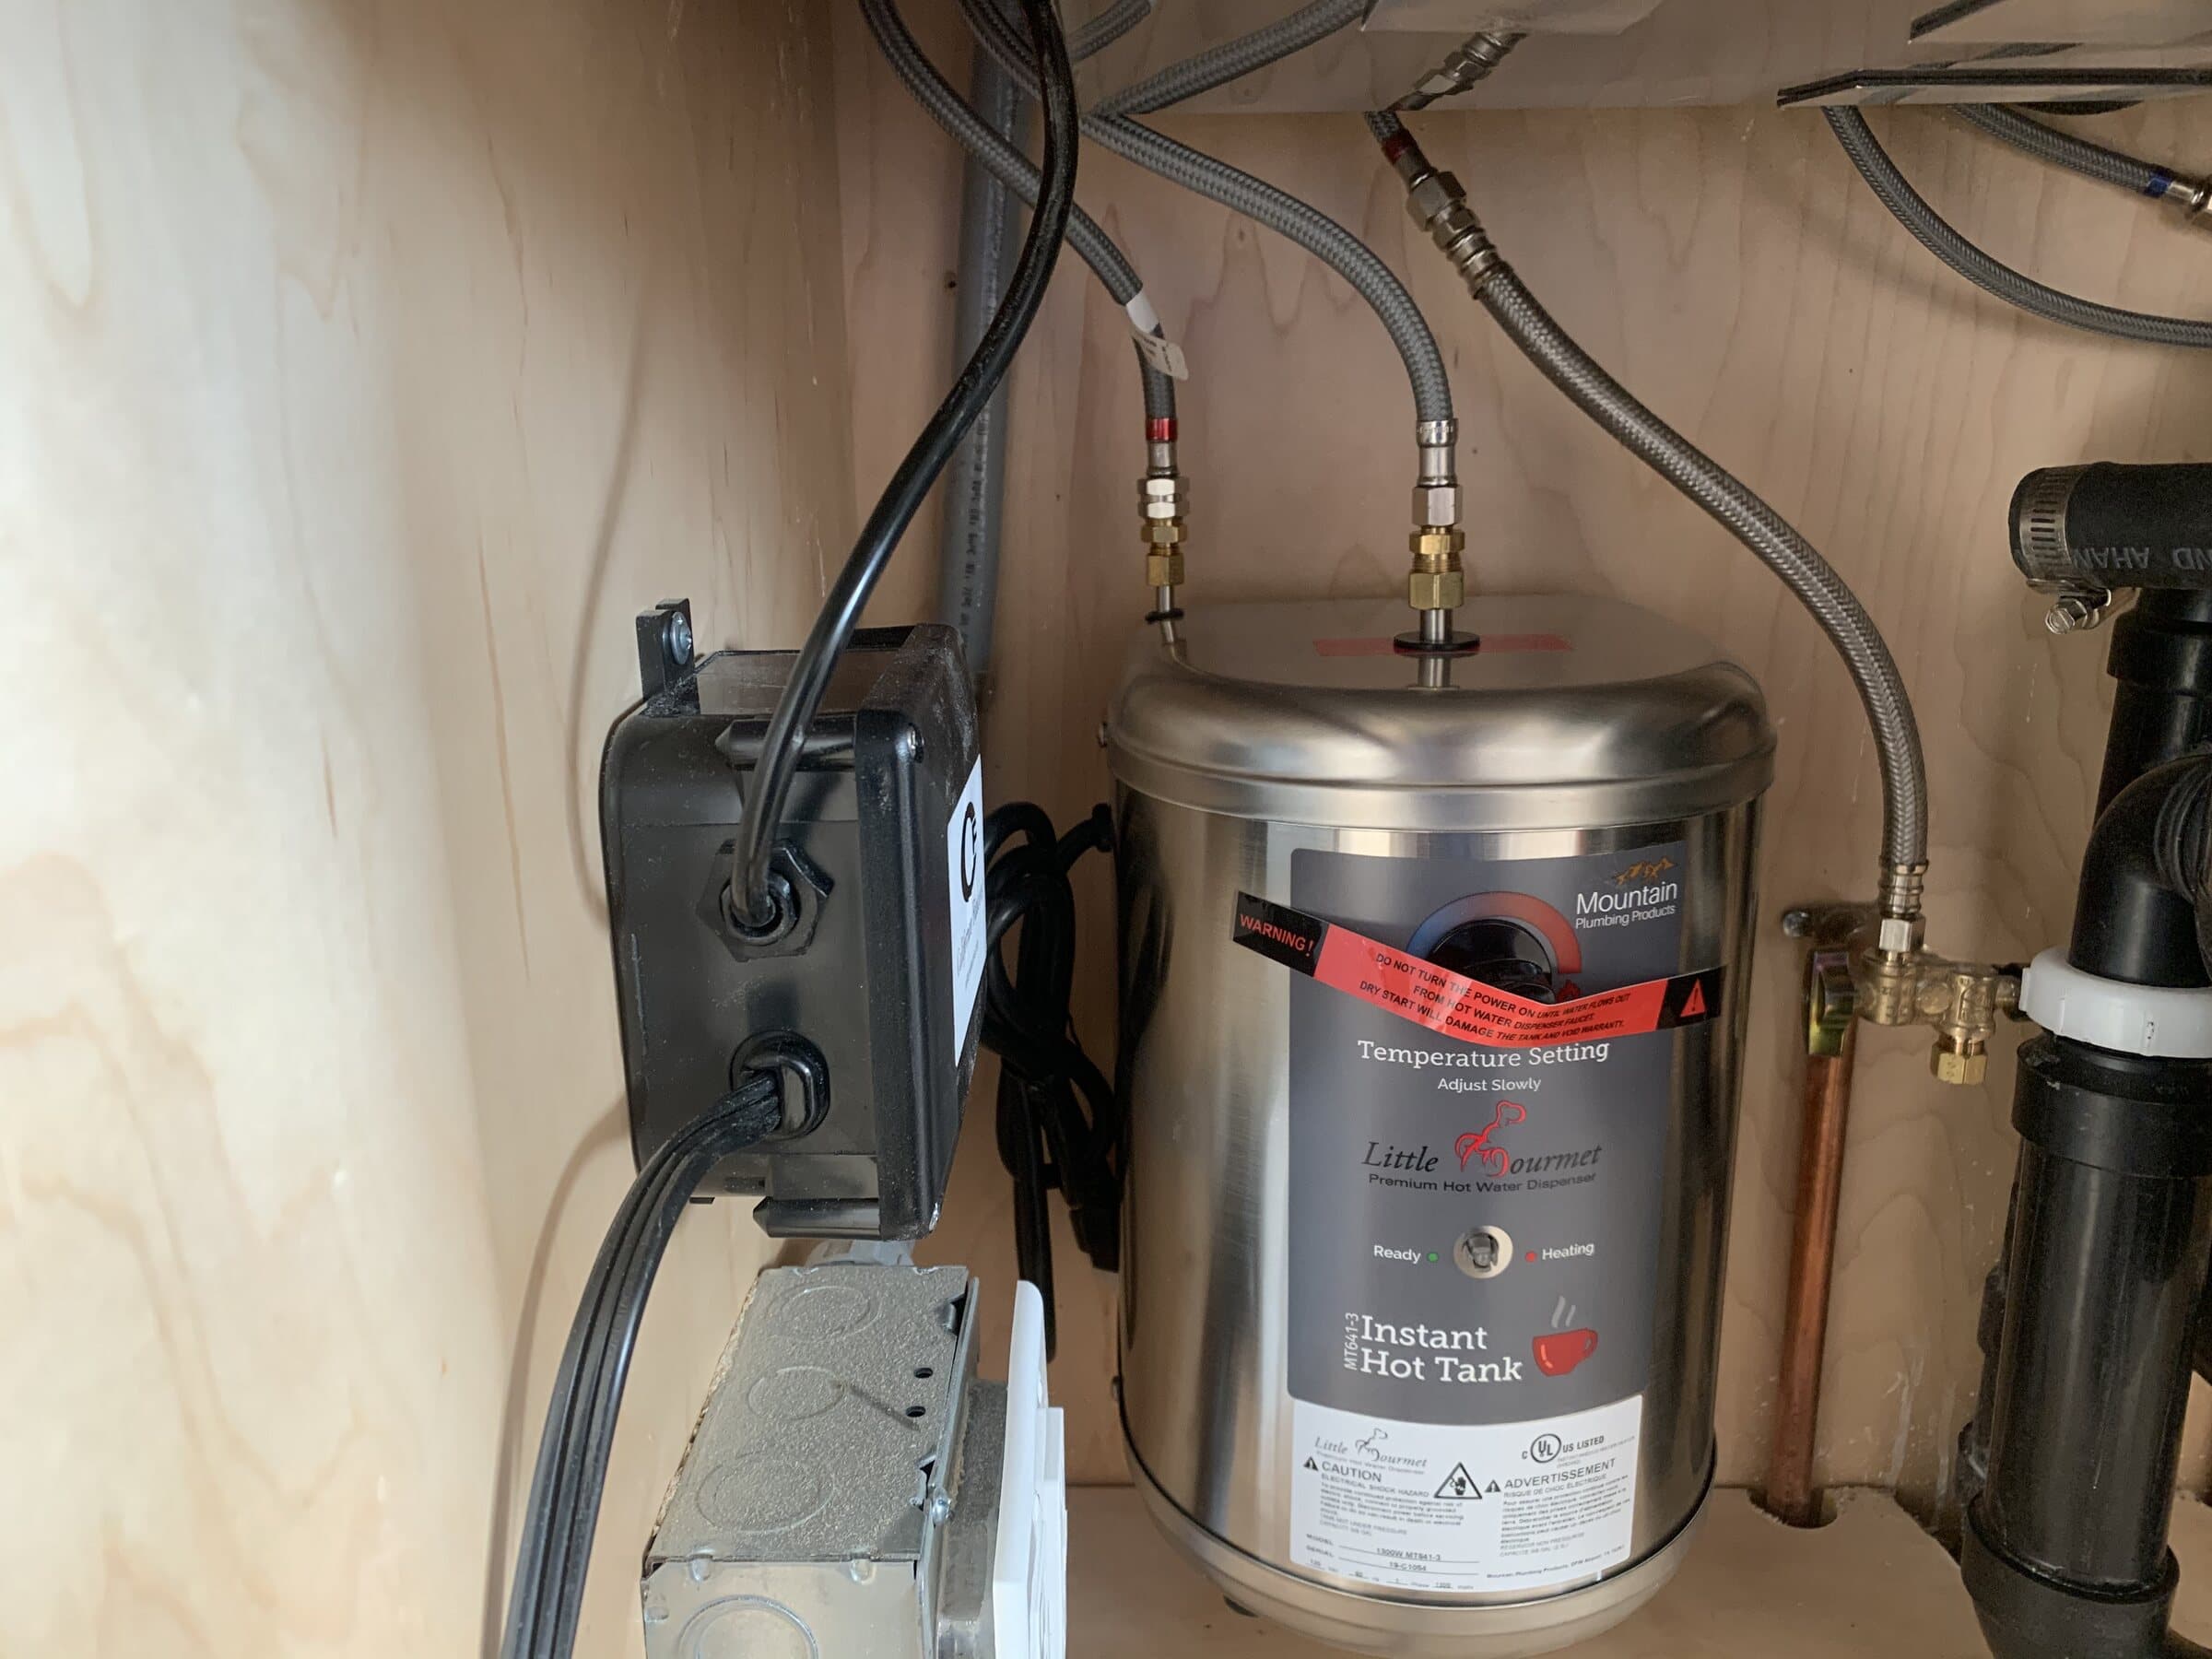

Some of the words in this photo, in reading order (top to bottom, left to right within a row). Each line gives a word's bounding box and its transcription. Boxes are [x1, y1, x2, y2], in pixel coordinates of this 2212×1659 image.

[1576, 881, 1677, 915] Mountain
[1575, 912, 1630, 929] Plumbing
[1631, 905, 1676, 922] Products
[1375, 953, 1393, 966] DO
[1393, 960, 1417, 975] NOT
[1418, 969, 1447, 989] TURN
[1449, 980, 1472, 998] THE
[1474, 991, 1516, 1013] POWER
[1518, 1006, 1535, 1018] ON
[1537, 1010, 1560, 1019] UNTIL
[1359, 980, 1381, 996] DRY
[1382, 989, 1416, 1009] START
[1417, 1004, 1441, 1023] WILL
[1445, 1016, 1494, 1039] DAMAGE
[1497, 1031, 1516, 1041] THE
[1517, 1032, 1542, 1041] TANK
[1542, 1031, 1560, 1040] AND
[1413, 985, 1445, 1005] FROM
[1447, 997, 1473, 1014] HOT
[1474, 1008, 1516, 1029] WATER
[1513, 1019, 1564, 1030] DISPENSER
[1358, 1040, 1522, 1069] Temperature
[1528, 1041, 1610, 1066] Setting
[1437, 1077, 1488, 1093] Adjust
[1491, 1077, 1542, 1092] Slowly
[1361, 1140, 1439, 1173] Little
[1369, 1173, 1438, 1192] Premium
[1443, 1180, 1472, 1193] Hot
[1477, 1181, 1524, 1193] Water
[1526, 1172, 1596, 1191] Dispenser
[1373, 1244, 1421, 1265] Ready
[1542, 1243, 1595, 1260] Heating
[1344, 1312, 1359, 1371] MT641-3
[1360, 1314, 1488, 1350] Instant
[1360, 1347, 1426, 1381] Hot
[1434, 1356, 1524, 1383] Tank
[1314, 1437, 1348, 1454] Little
[1562, 1443, 1574, 1453] US
[1577, 1435, 1605, 1450] LISTED
[1322, 1461, 1382, 1482] CAUTION
[1504, 1458, 1616, 1489] ADVERTISSEMENT
[1398, 1488, 1430, 1498] HAZARD
